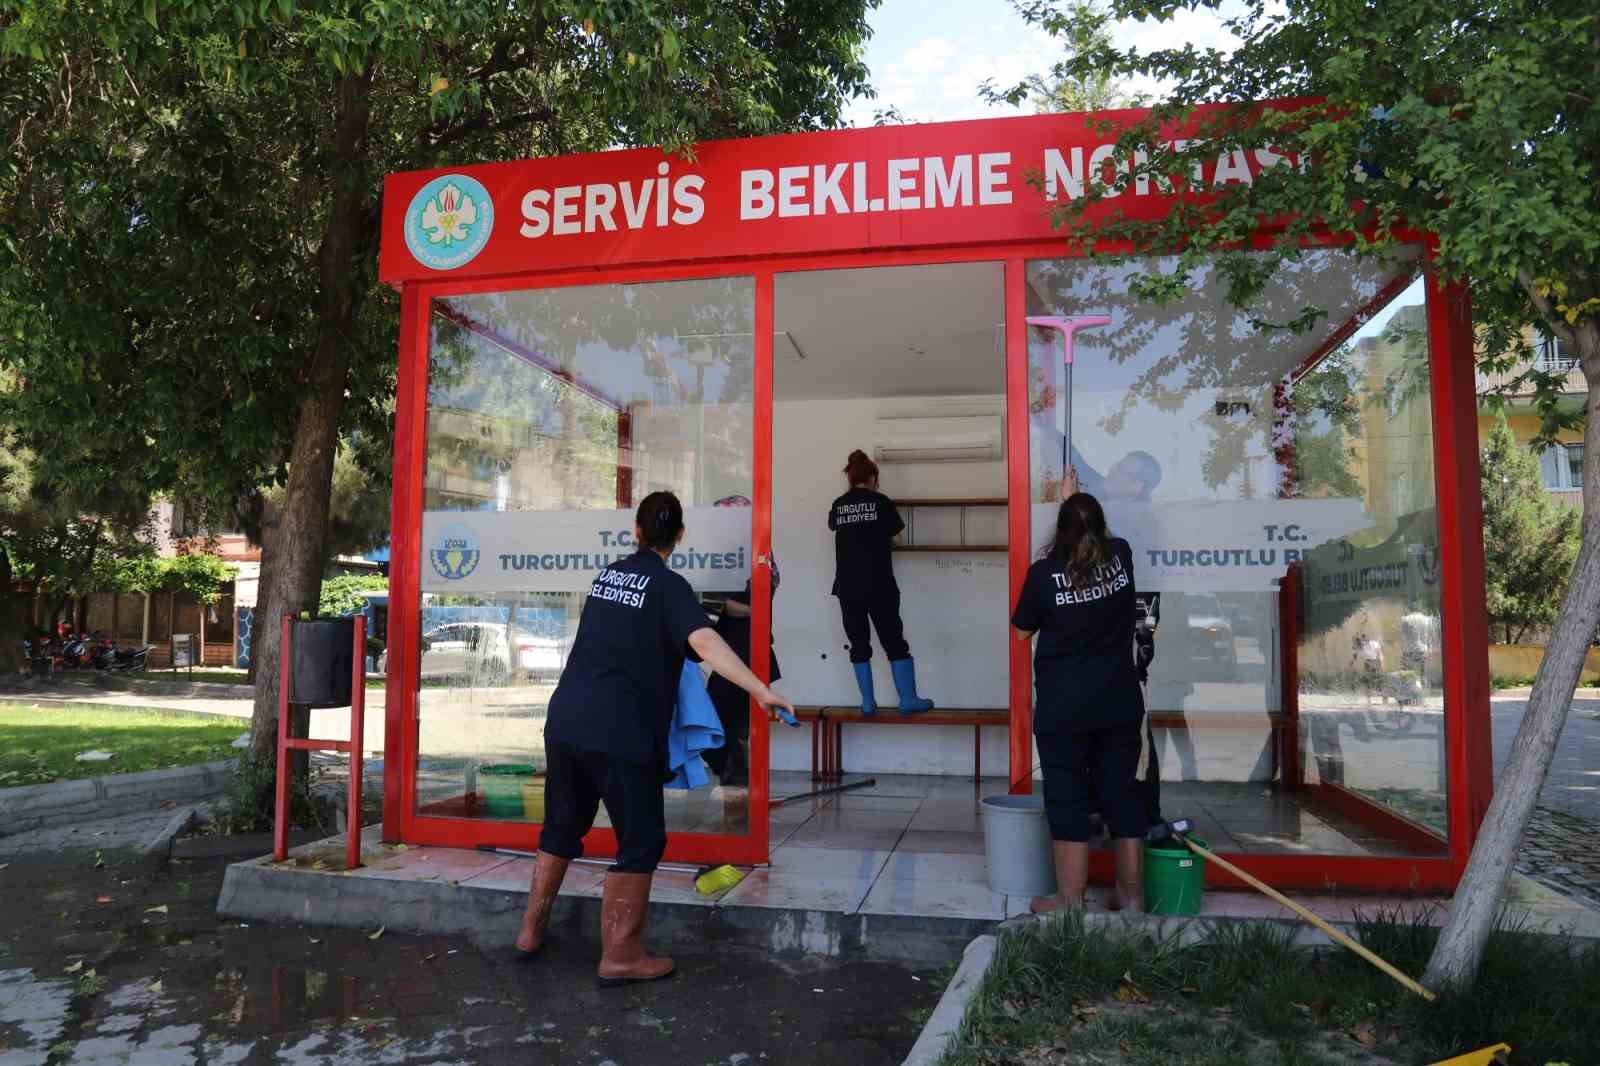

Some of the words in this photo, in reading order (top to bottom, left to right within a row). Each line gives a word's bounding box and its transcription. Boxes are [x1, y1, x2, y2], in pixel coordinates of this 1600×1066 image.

[519, 161, 705, 239] SERVİS
[740, 151, 1012, 220] BEKLEME
[599, 530, 640, 547] T.C.
[1264, 524, 1308, 541] T.C.
[498, 553, 609, 570] TURGUTLU
[1147, 549, 1276, 566] TURGUTLU
[599, 568, 650, 590] URGUTLU
[587, 583, 646, 609] ELEDİYESİ
